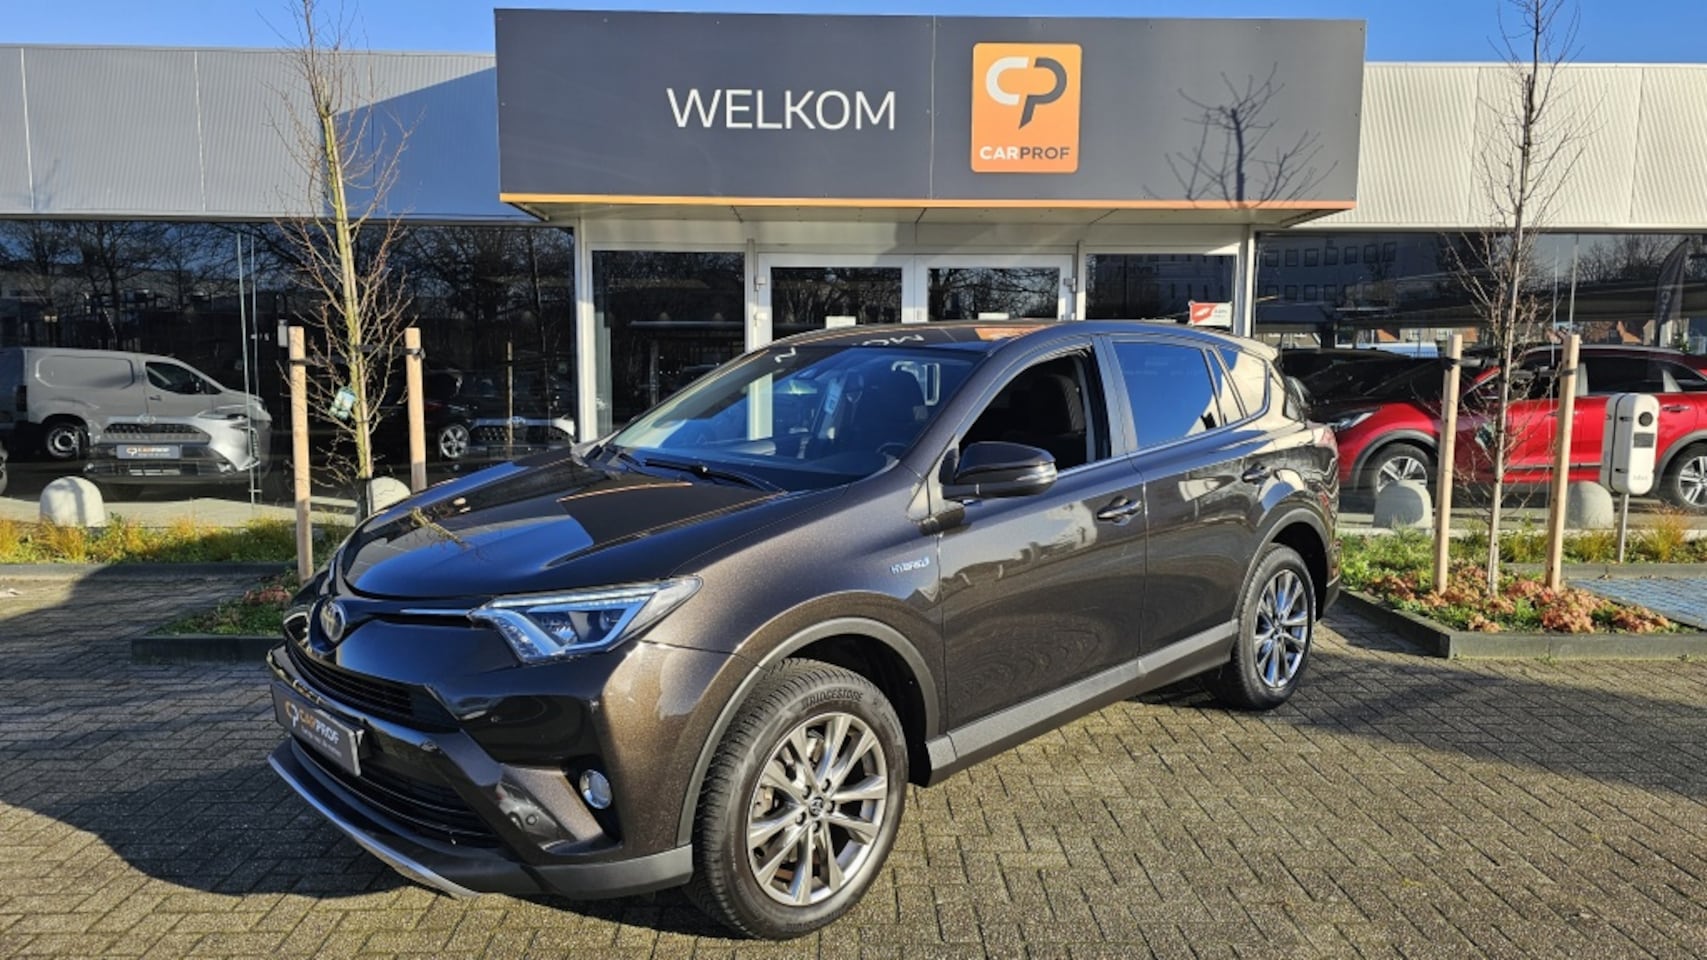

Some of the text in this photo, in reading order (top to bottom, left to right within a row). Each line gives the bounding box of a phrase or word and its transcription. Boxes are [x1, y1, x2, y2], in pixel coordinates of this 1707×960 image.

[666, 88, 896, 130] WELKOM
[979, 145, 1071, 160] CARPROF
[299, 709, 340, 745] CARPROF
